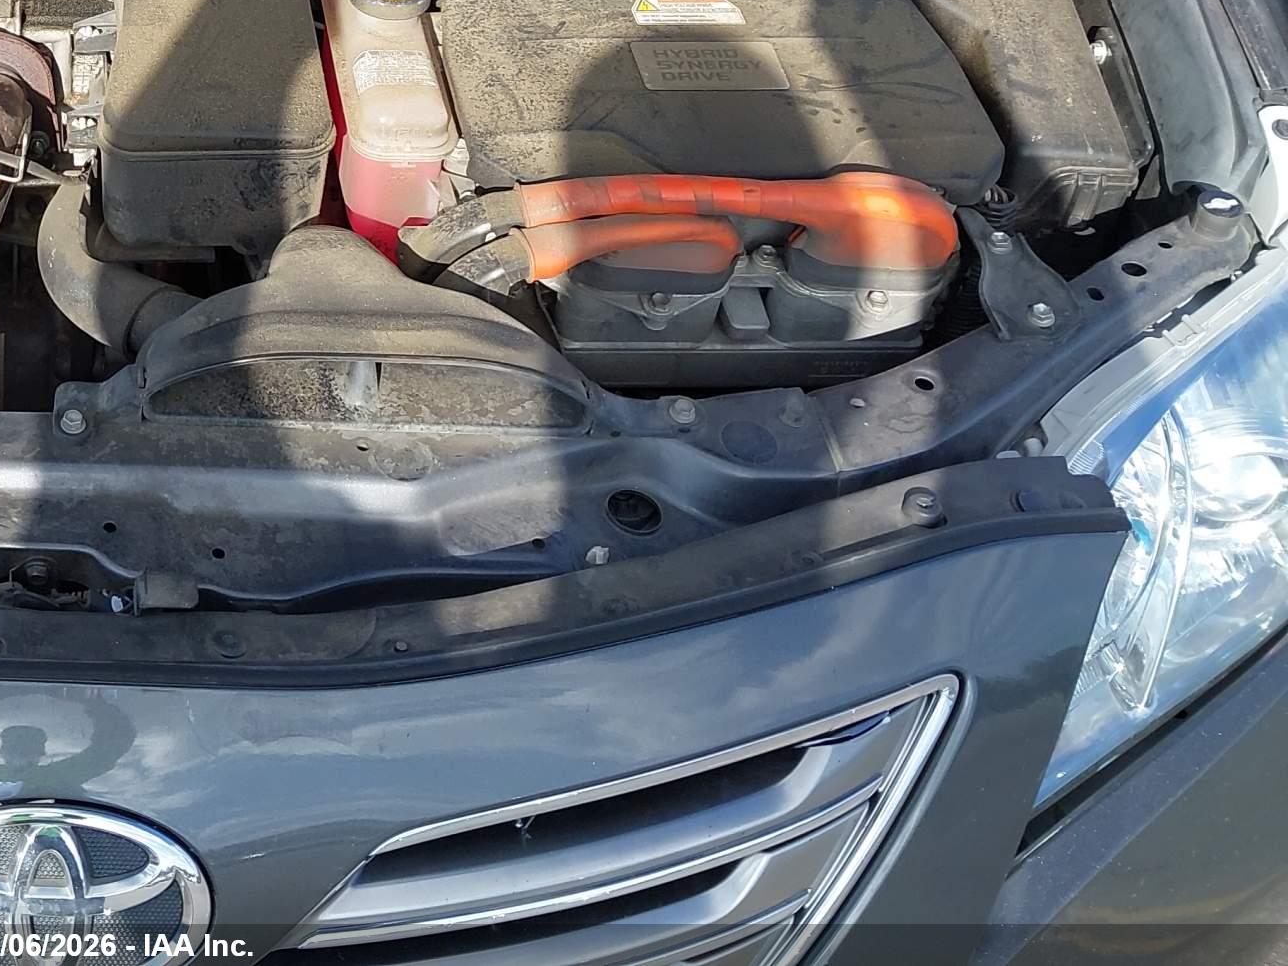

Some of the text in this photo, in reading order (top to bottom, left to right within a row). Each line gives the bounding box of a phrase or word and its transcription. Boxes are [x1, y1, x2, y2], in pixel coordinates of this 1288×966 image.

[653, 48, 739, 59] HYBRID
[656, 59, 762, 70] SYNERGY
[662, 71, 731, 82] DRIVE
